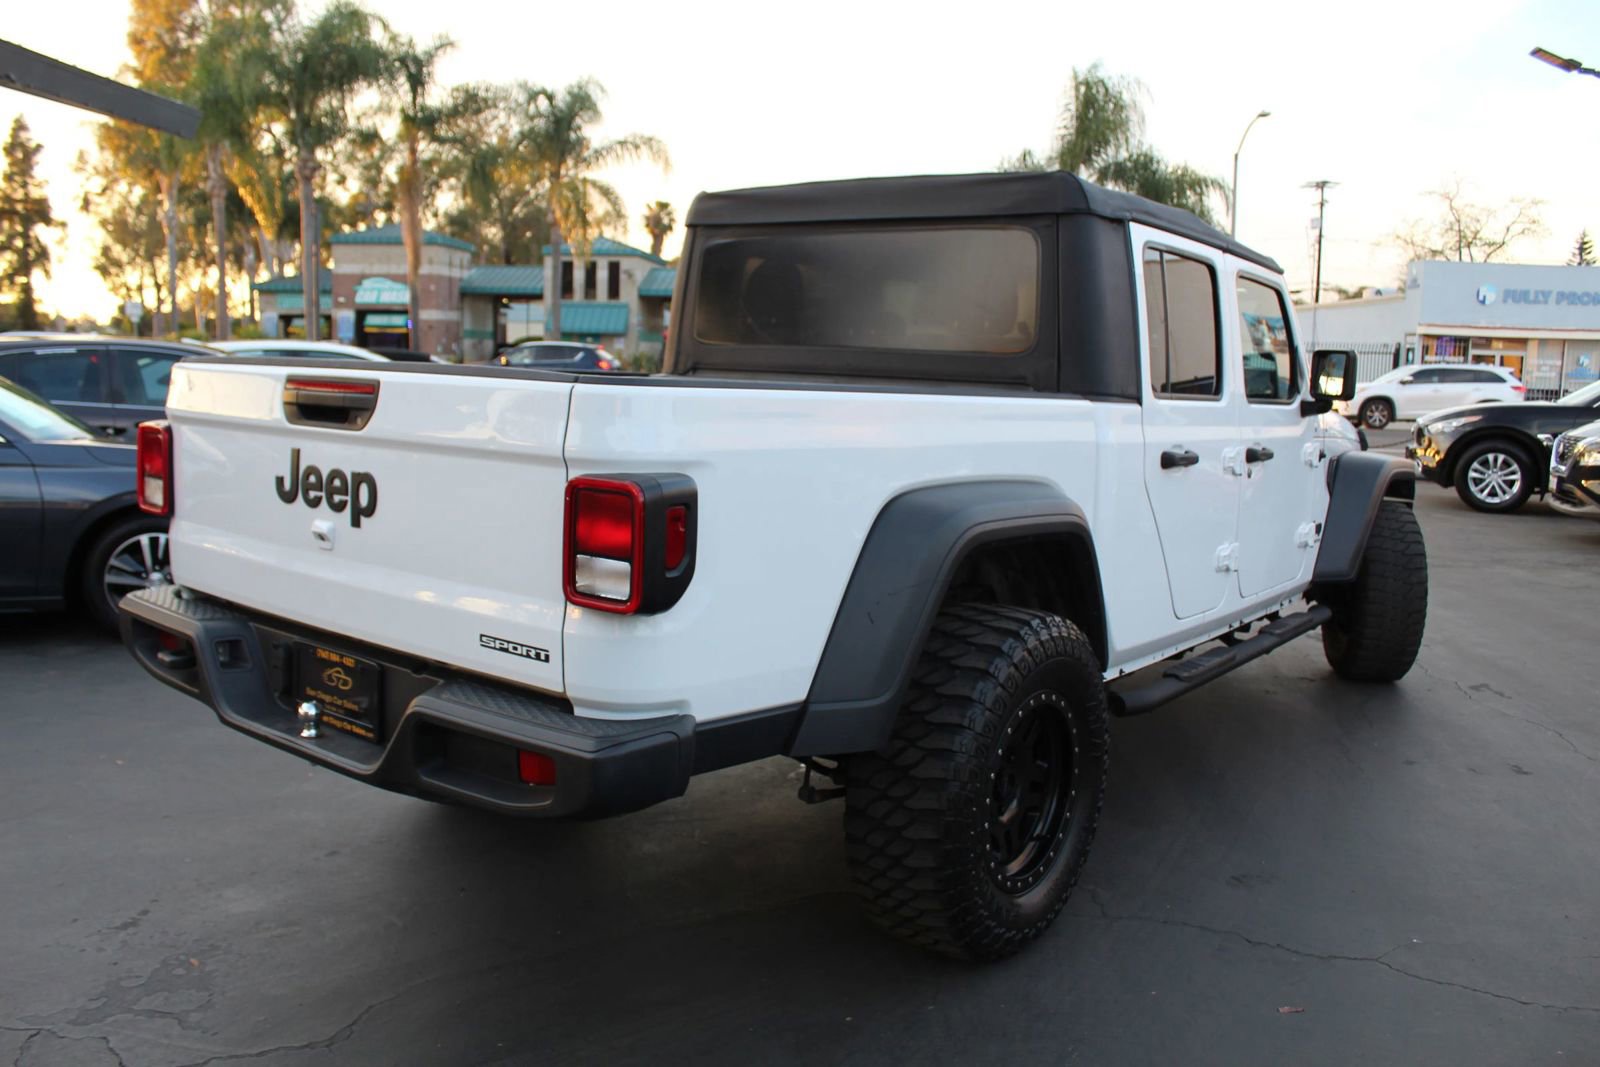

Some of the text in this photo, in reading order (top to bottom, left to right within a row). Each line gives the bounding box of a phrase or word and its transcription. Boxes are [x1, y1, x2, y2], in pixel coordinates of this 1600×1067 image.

[1502, 288, 1552, 304] FULLY
[275, 448, 378, 529] Jeep
[480, 635, 549, 661] SPORT
